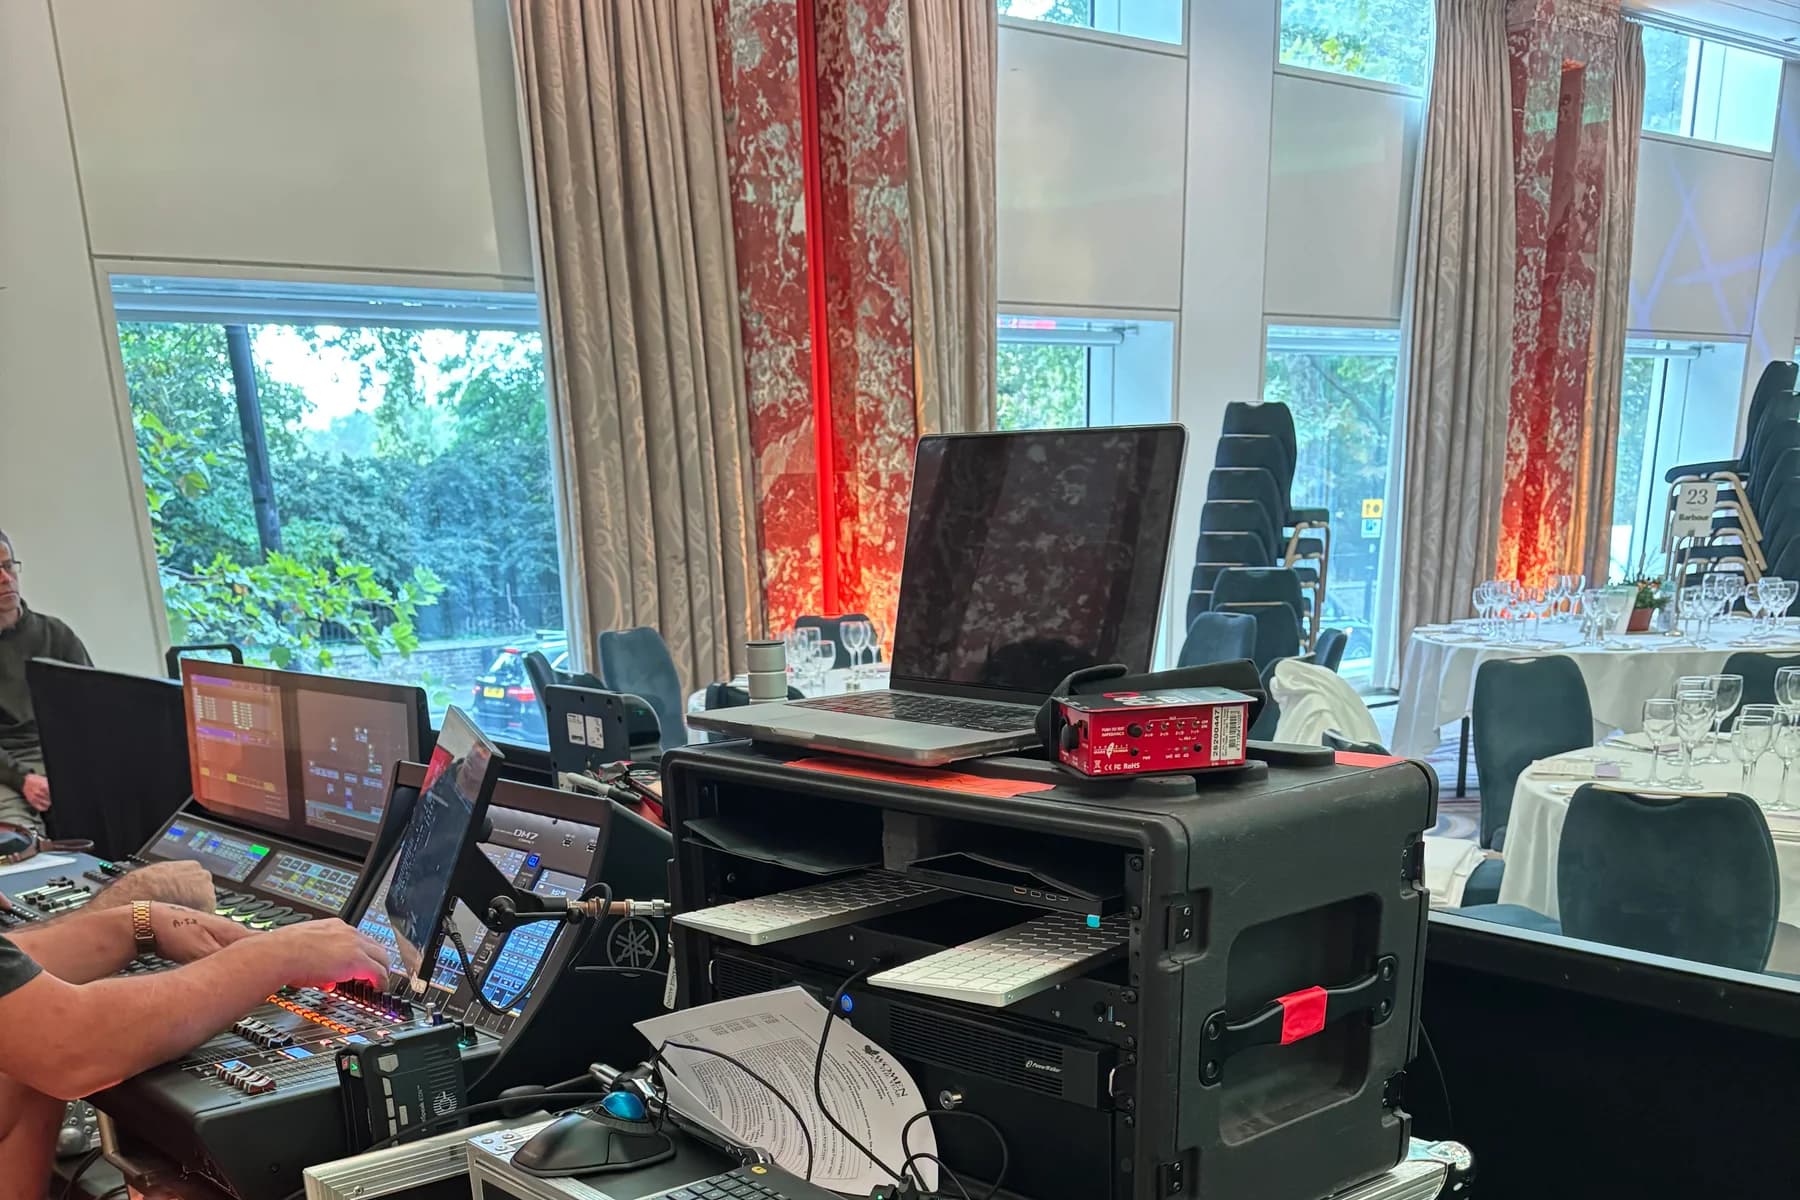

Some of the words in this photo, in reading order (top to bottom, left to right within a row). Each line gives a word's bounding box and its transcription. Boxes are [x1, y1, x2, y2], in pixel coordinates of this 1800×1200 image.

[1686, 489, 1708, 505] 23
[1678, 513, 1710, 521] Barbour
[513, 828, 539, 841] DM7
[873, 1055, 908, 1097] WOMEN
